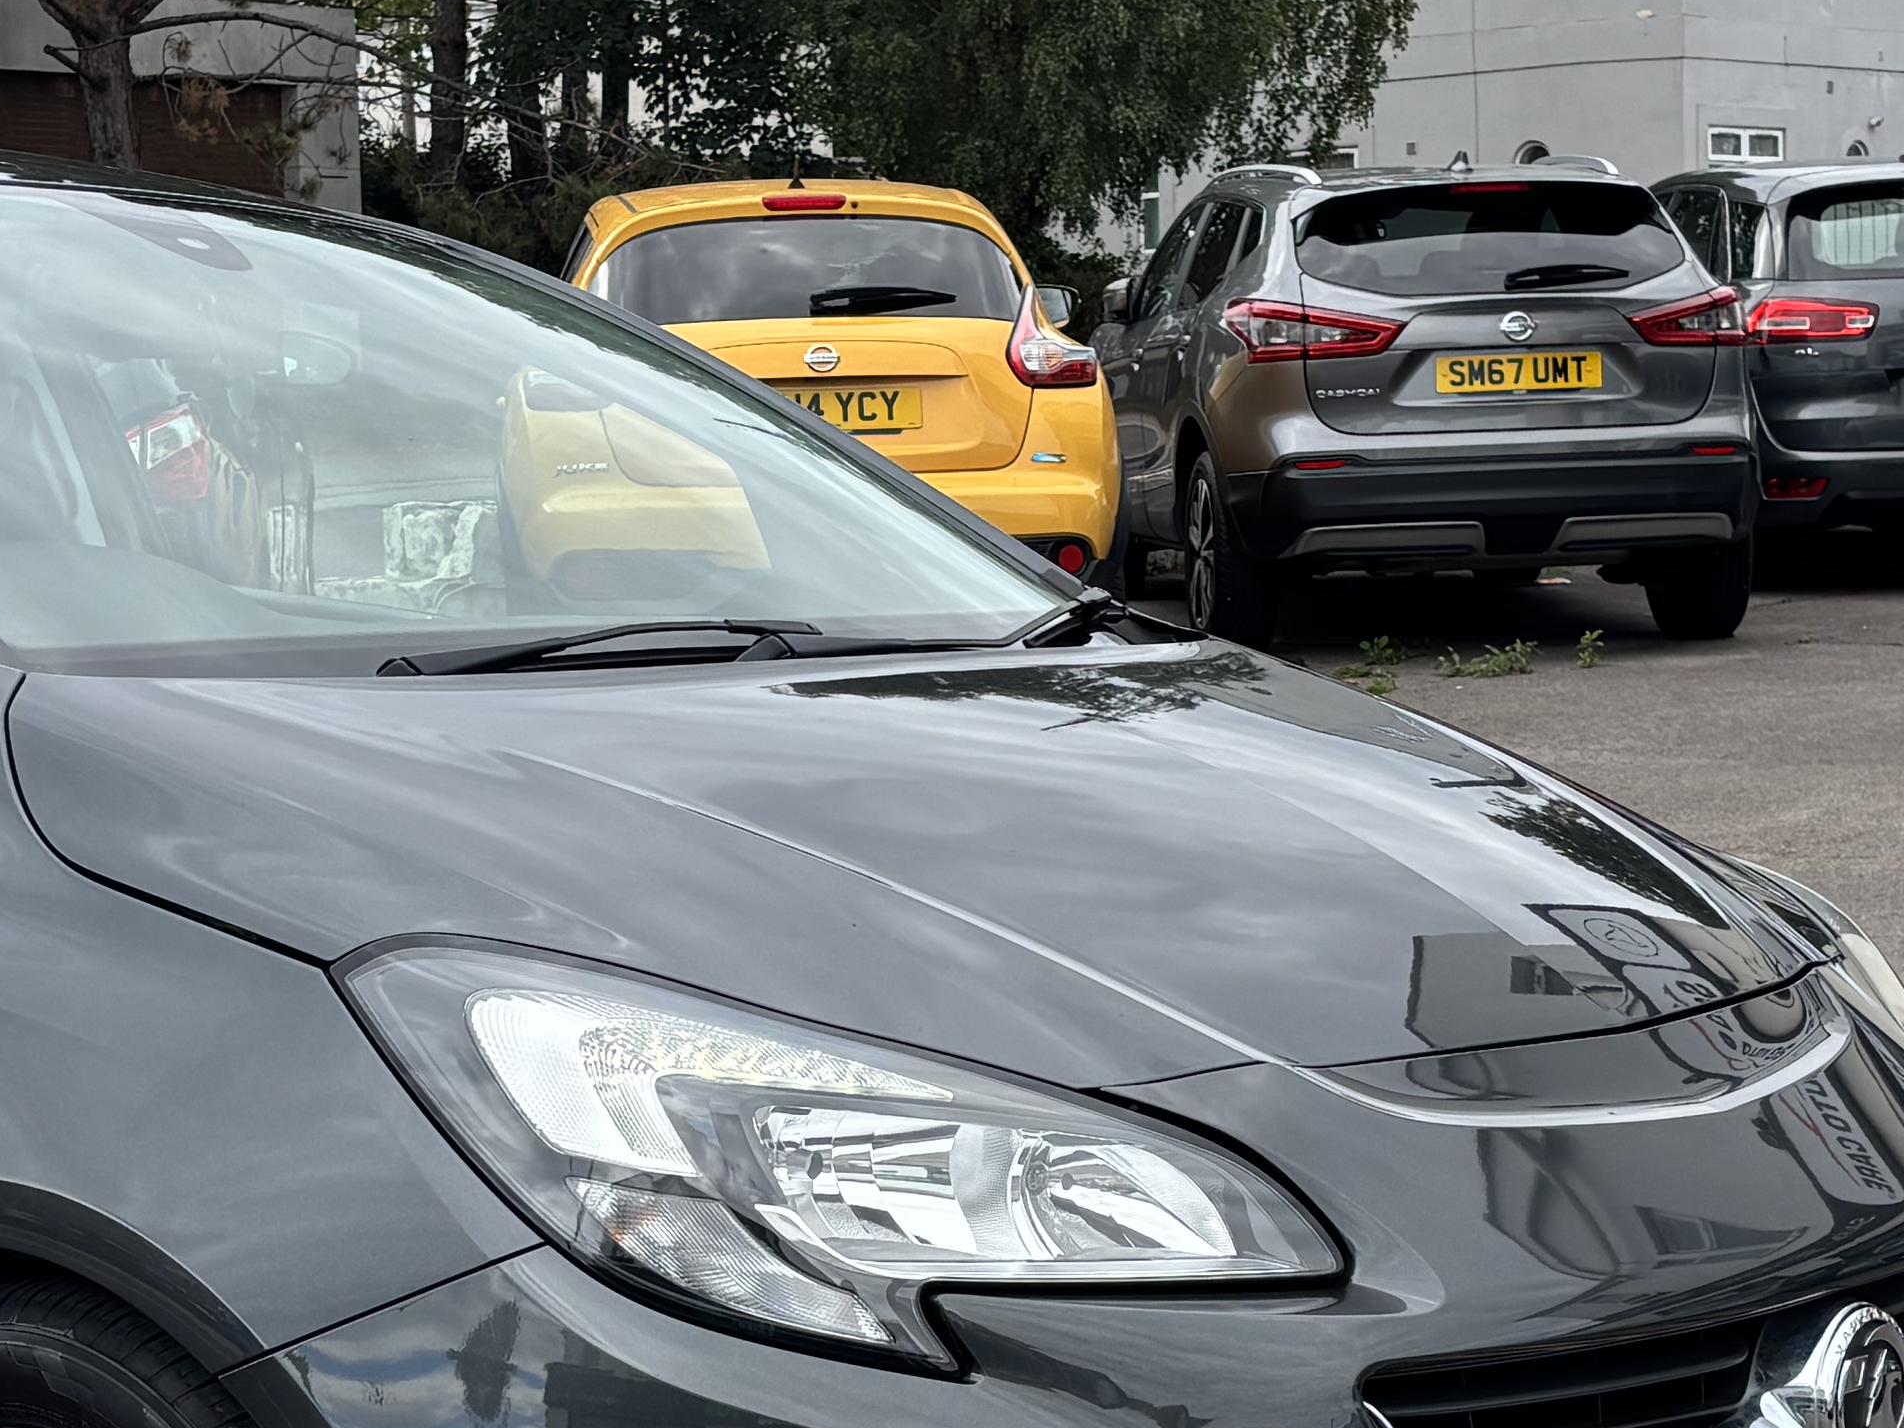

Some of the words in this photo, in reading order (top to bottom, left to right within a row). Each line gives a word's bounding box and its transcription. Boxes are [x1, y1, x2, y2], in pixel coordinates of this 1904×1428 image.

[1448, 357, 1525, 387] SM67
[1533, 355, 1587, 384] UMT
[835, 390, 900, 423] YCY
